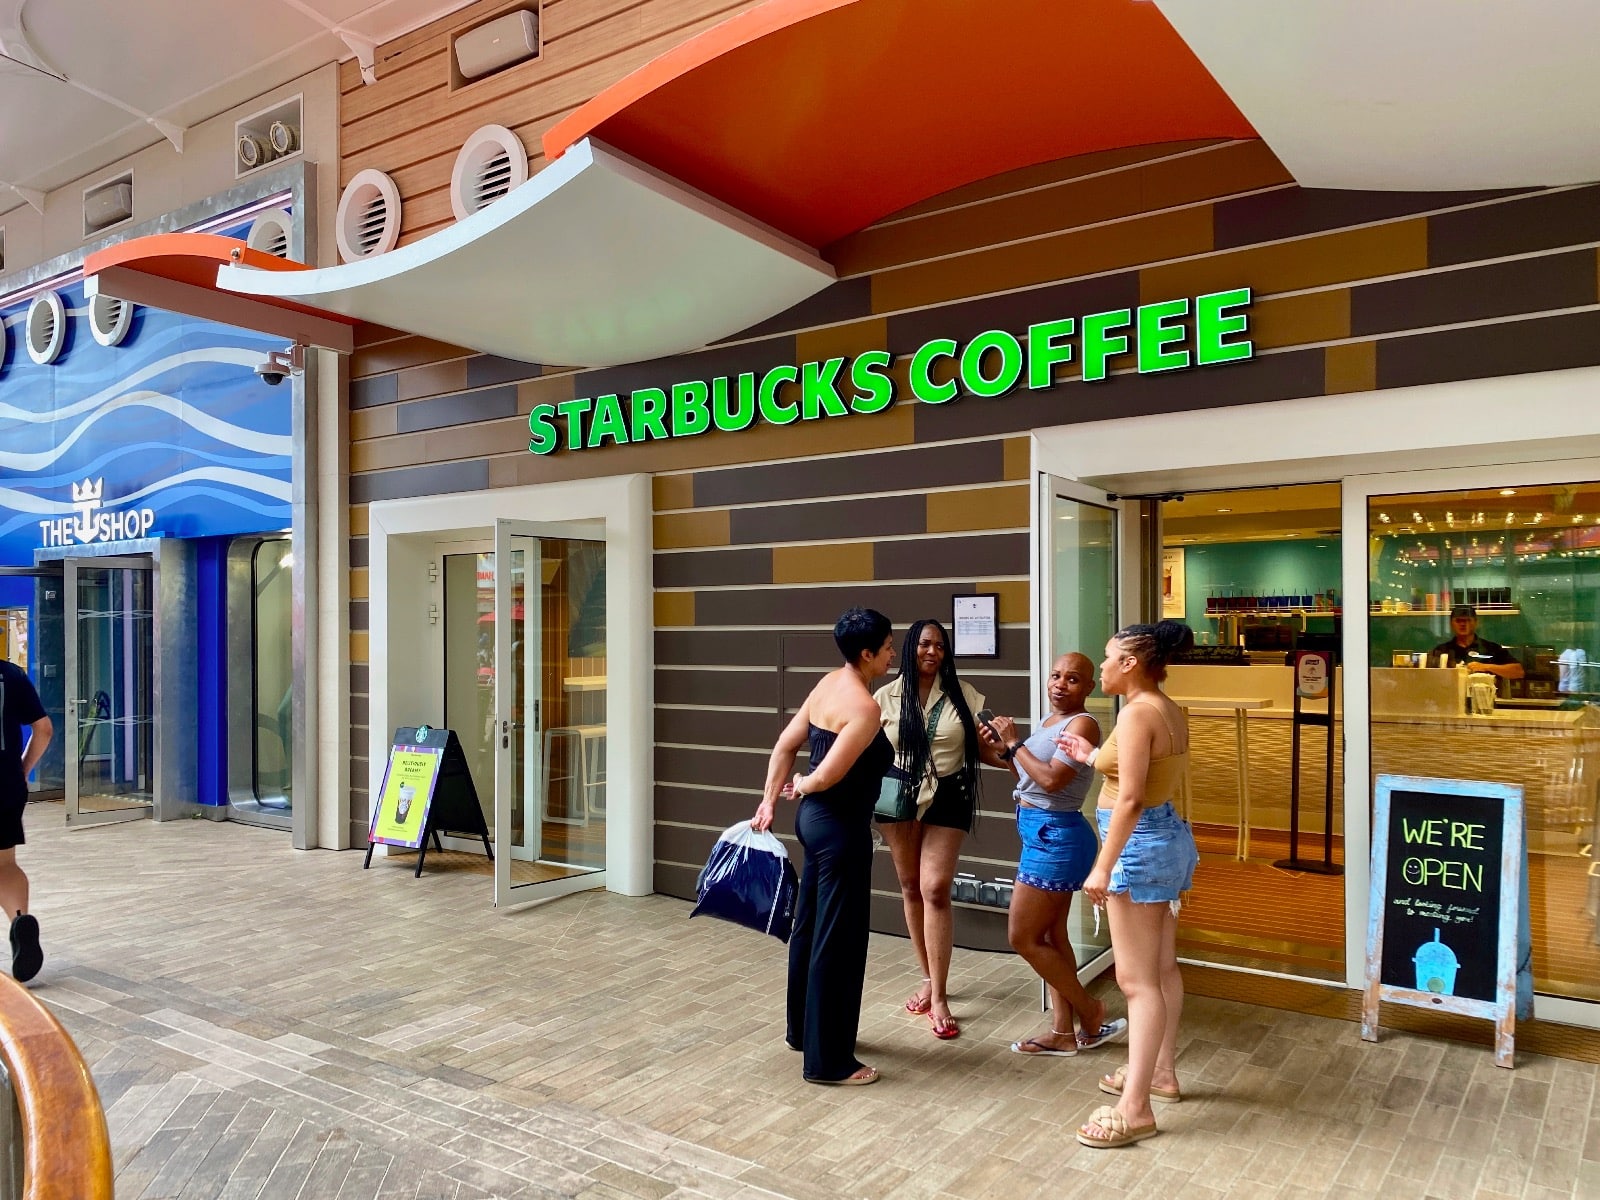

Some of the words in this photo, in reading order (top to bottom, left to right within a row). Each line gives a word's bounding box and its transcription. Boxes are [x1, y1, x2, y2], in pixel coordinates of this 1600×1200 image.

[528, 351, 894, 455] STARBUCKS
[909, 287, 1253, 405] COFFEE
[39, 517, 74, 547] THE
[99, 507, 154, 542] SHOP
[1402, 817, 1486, 851] WE'RE
[1402, 857, 1483, 893] OPEN
